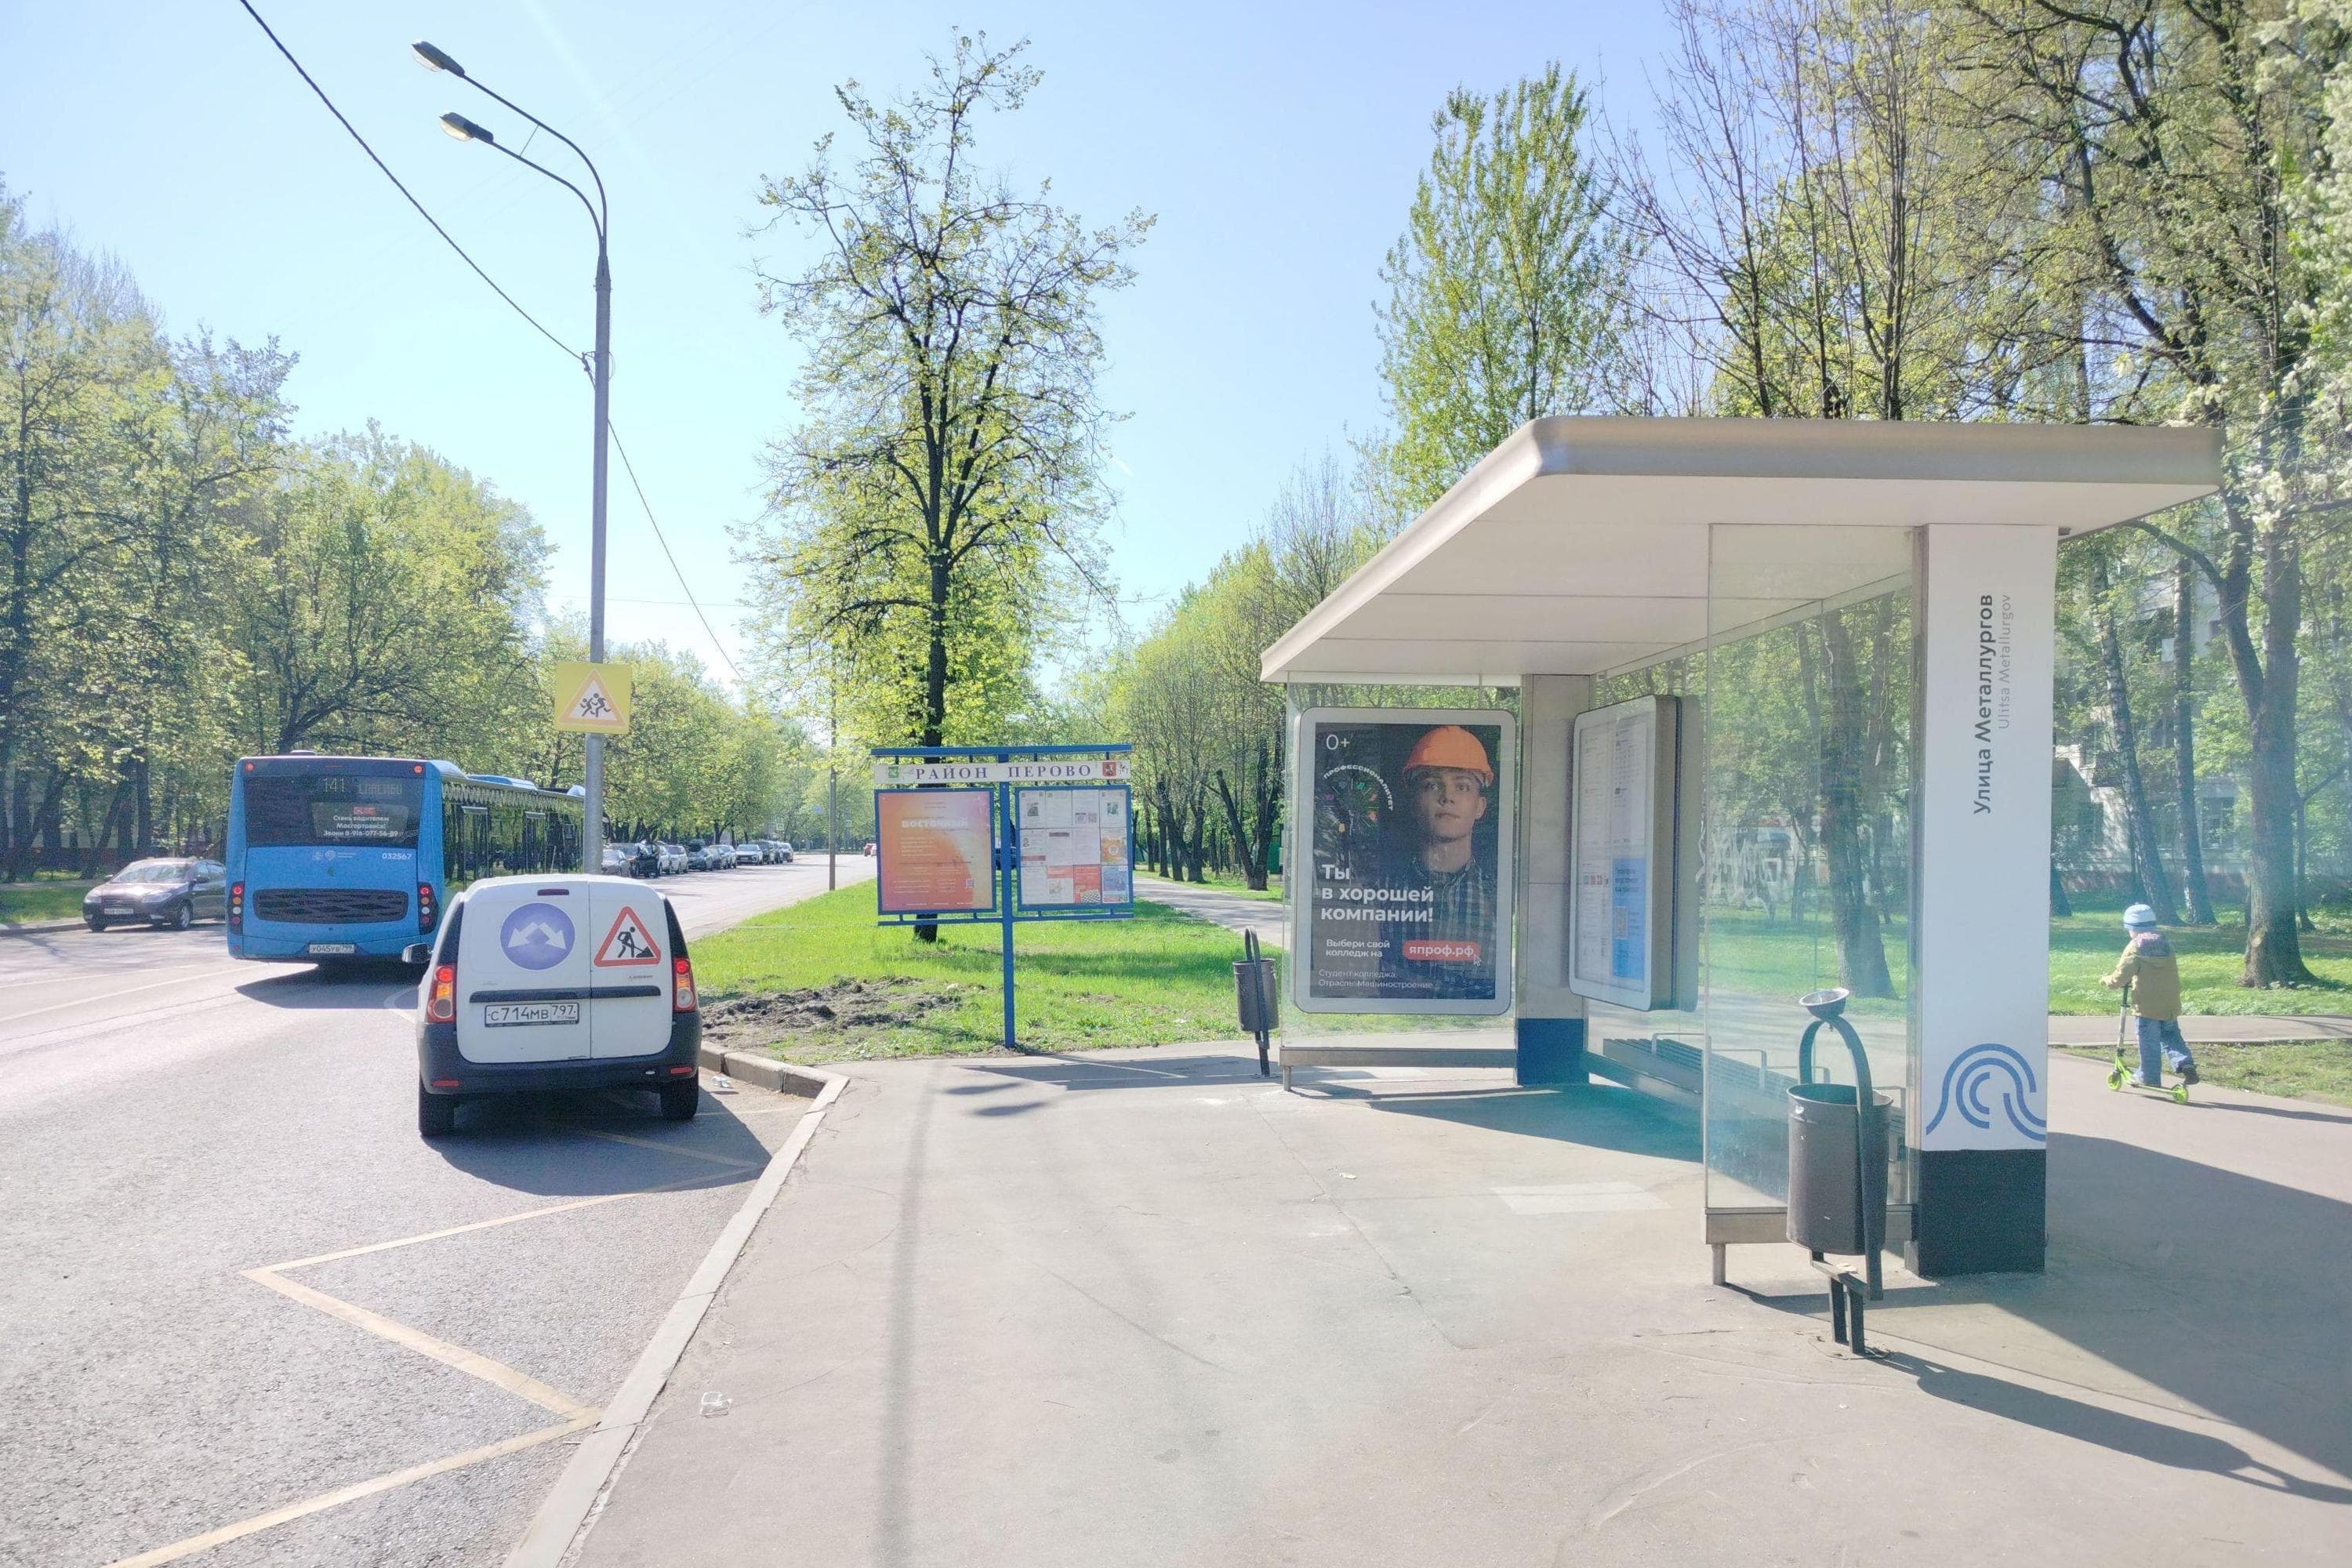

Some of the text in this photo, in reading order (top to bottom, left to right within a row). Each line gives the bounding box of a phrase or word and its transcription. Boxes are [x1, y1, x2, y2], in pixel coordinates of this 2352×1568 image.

[1998, 594, 2014, 729] Ulitsa Metallurgov
[1973, 594, 1996, 815] Улица Металлургов
[1326, 734, 1350, 750] 0+
[916, 764, 1091, 780] РАЙОН ПЕРОВО
[1323, 764, 1393, 811] ПРОФЕССИОНАЛИТЕТ
[1321, 864, 1350, 880] Ты
[1322, 886, 1434, 904] в хорошей
[1321, 907, 1434, 923] компании!
[1326, 939, 1390, 950] Выбери свой
[1408, 944, 1475, 957] япроф.рф
[1326, 949, 1370, 958] колледж
[1318, 969, 1352, 978] Студент
[551, 1004, 573, 1016] 797
